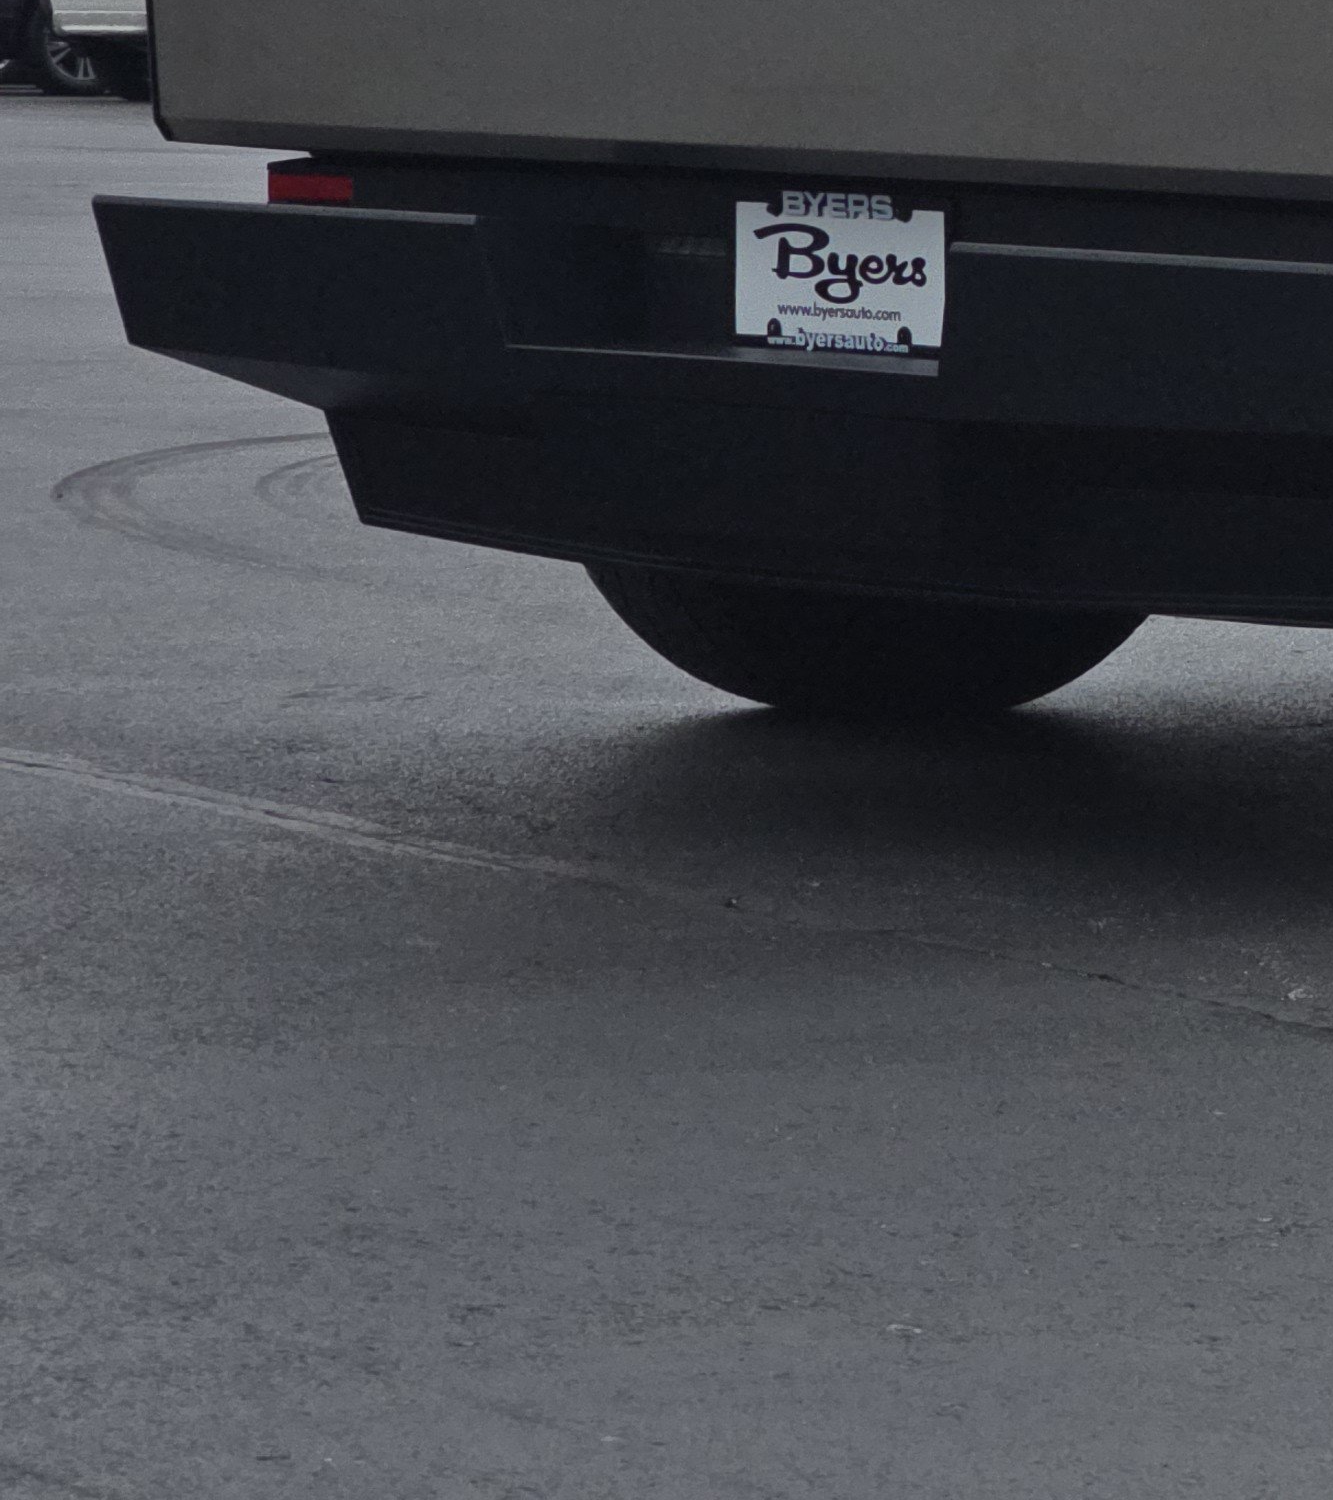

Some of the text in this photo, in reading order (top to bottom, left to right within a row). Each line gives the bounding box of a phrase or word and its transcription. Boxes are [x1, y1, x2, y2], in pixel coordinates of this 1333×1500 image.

[784, 191, 893, 219] BYERS
[754, 223, 926, 303] Byers
[778, 302, 901, 321] www.byersauto.com
